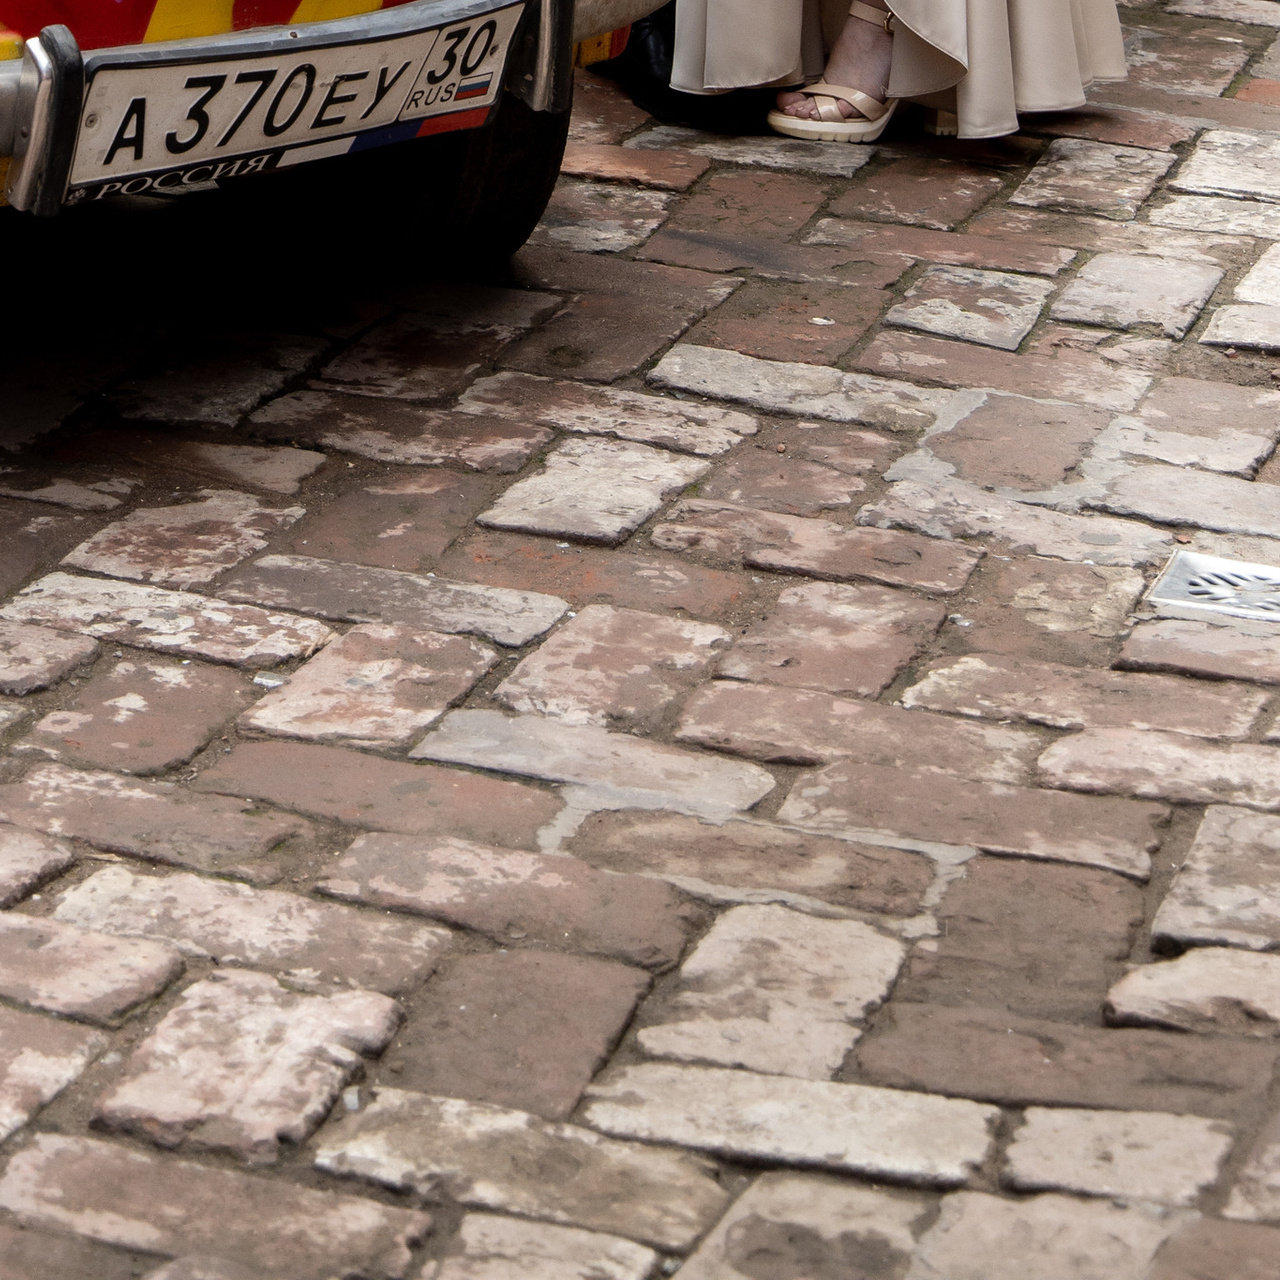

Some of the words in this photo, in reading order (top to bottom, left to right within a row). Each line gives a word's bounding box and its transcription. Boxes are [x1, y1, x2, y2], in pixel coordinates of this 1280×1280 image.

[426, 19, 498, 85] 30
[406, 82, 457, 111] RUS
[93, 153, 274, 201] РОССИЯ
